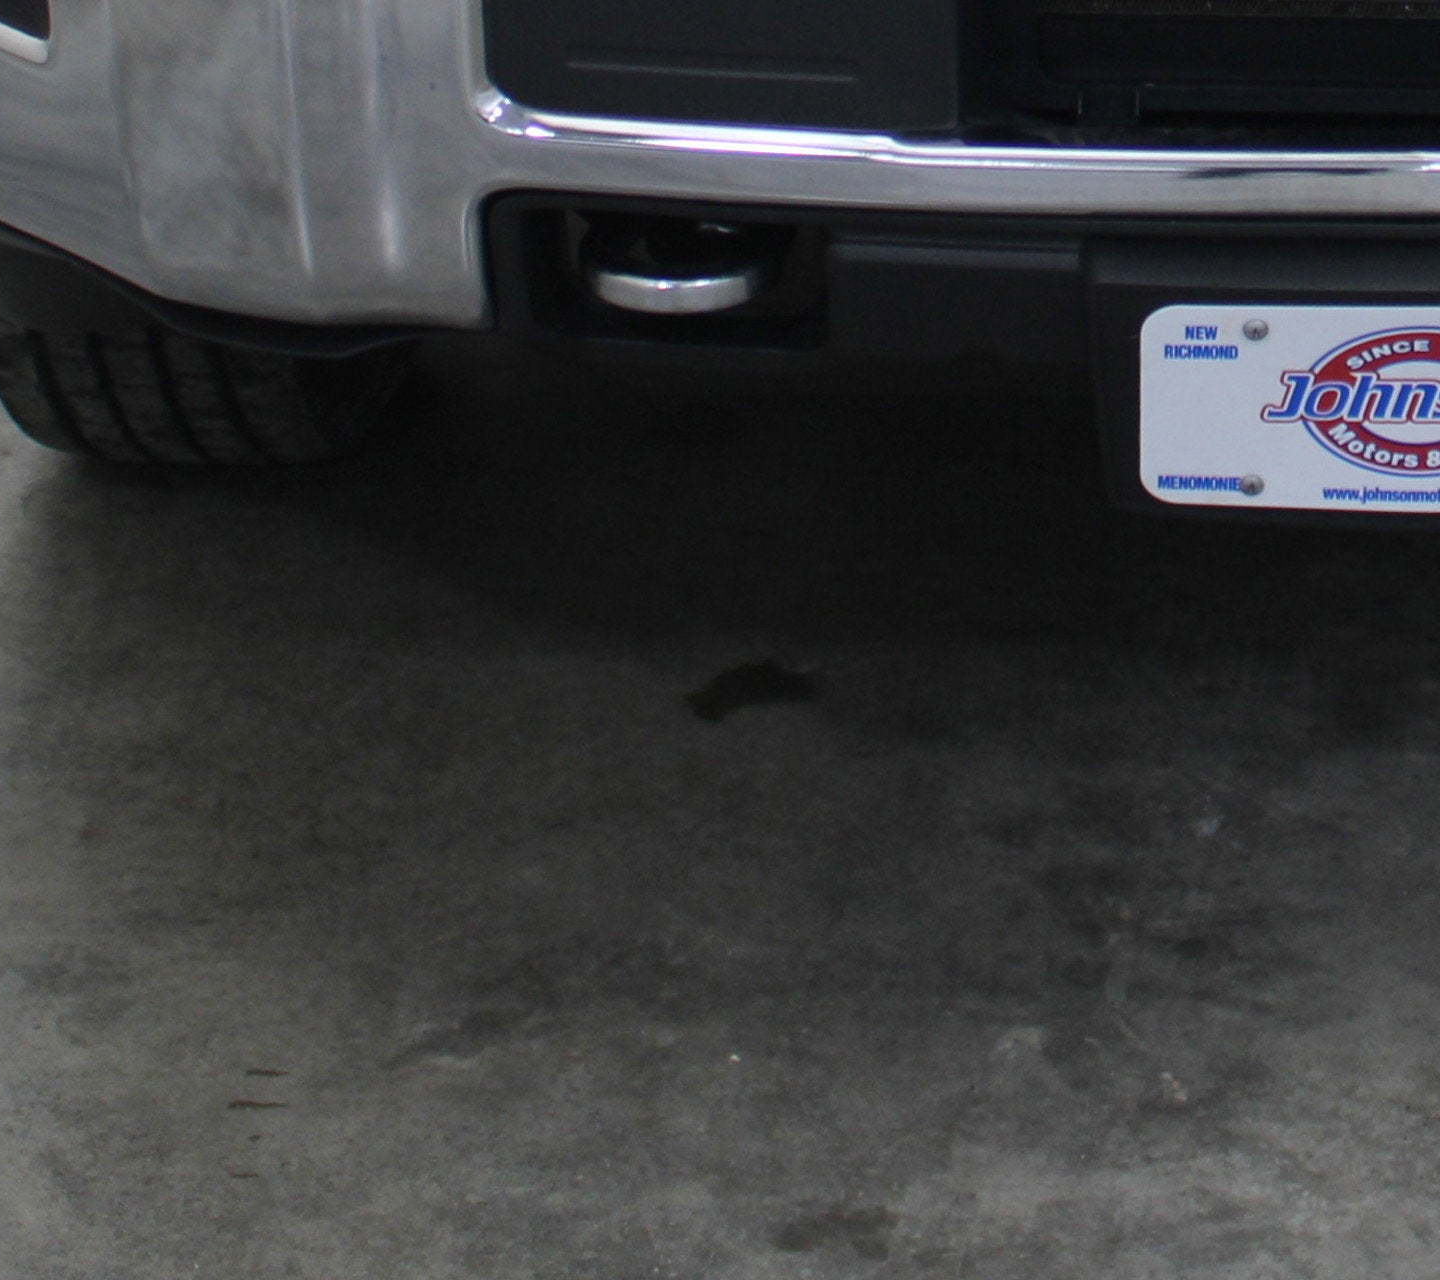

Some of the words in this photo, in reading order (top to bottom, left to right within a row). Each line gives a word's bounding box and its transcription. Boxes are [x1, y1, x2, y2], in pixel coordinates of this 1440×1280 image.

[1185, 325, 1219, 340] NEW
[1164, 344, 1239, 360] RICHMOND
[1345, 339, 1431, 372] SINCE
[1328, 422, 1420, 469] Motors
[1158, 474, 1242, 492] MENOMONIE
